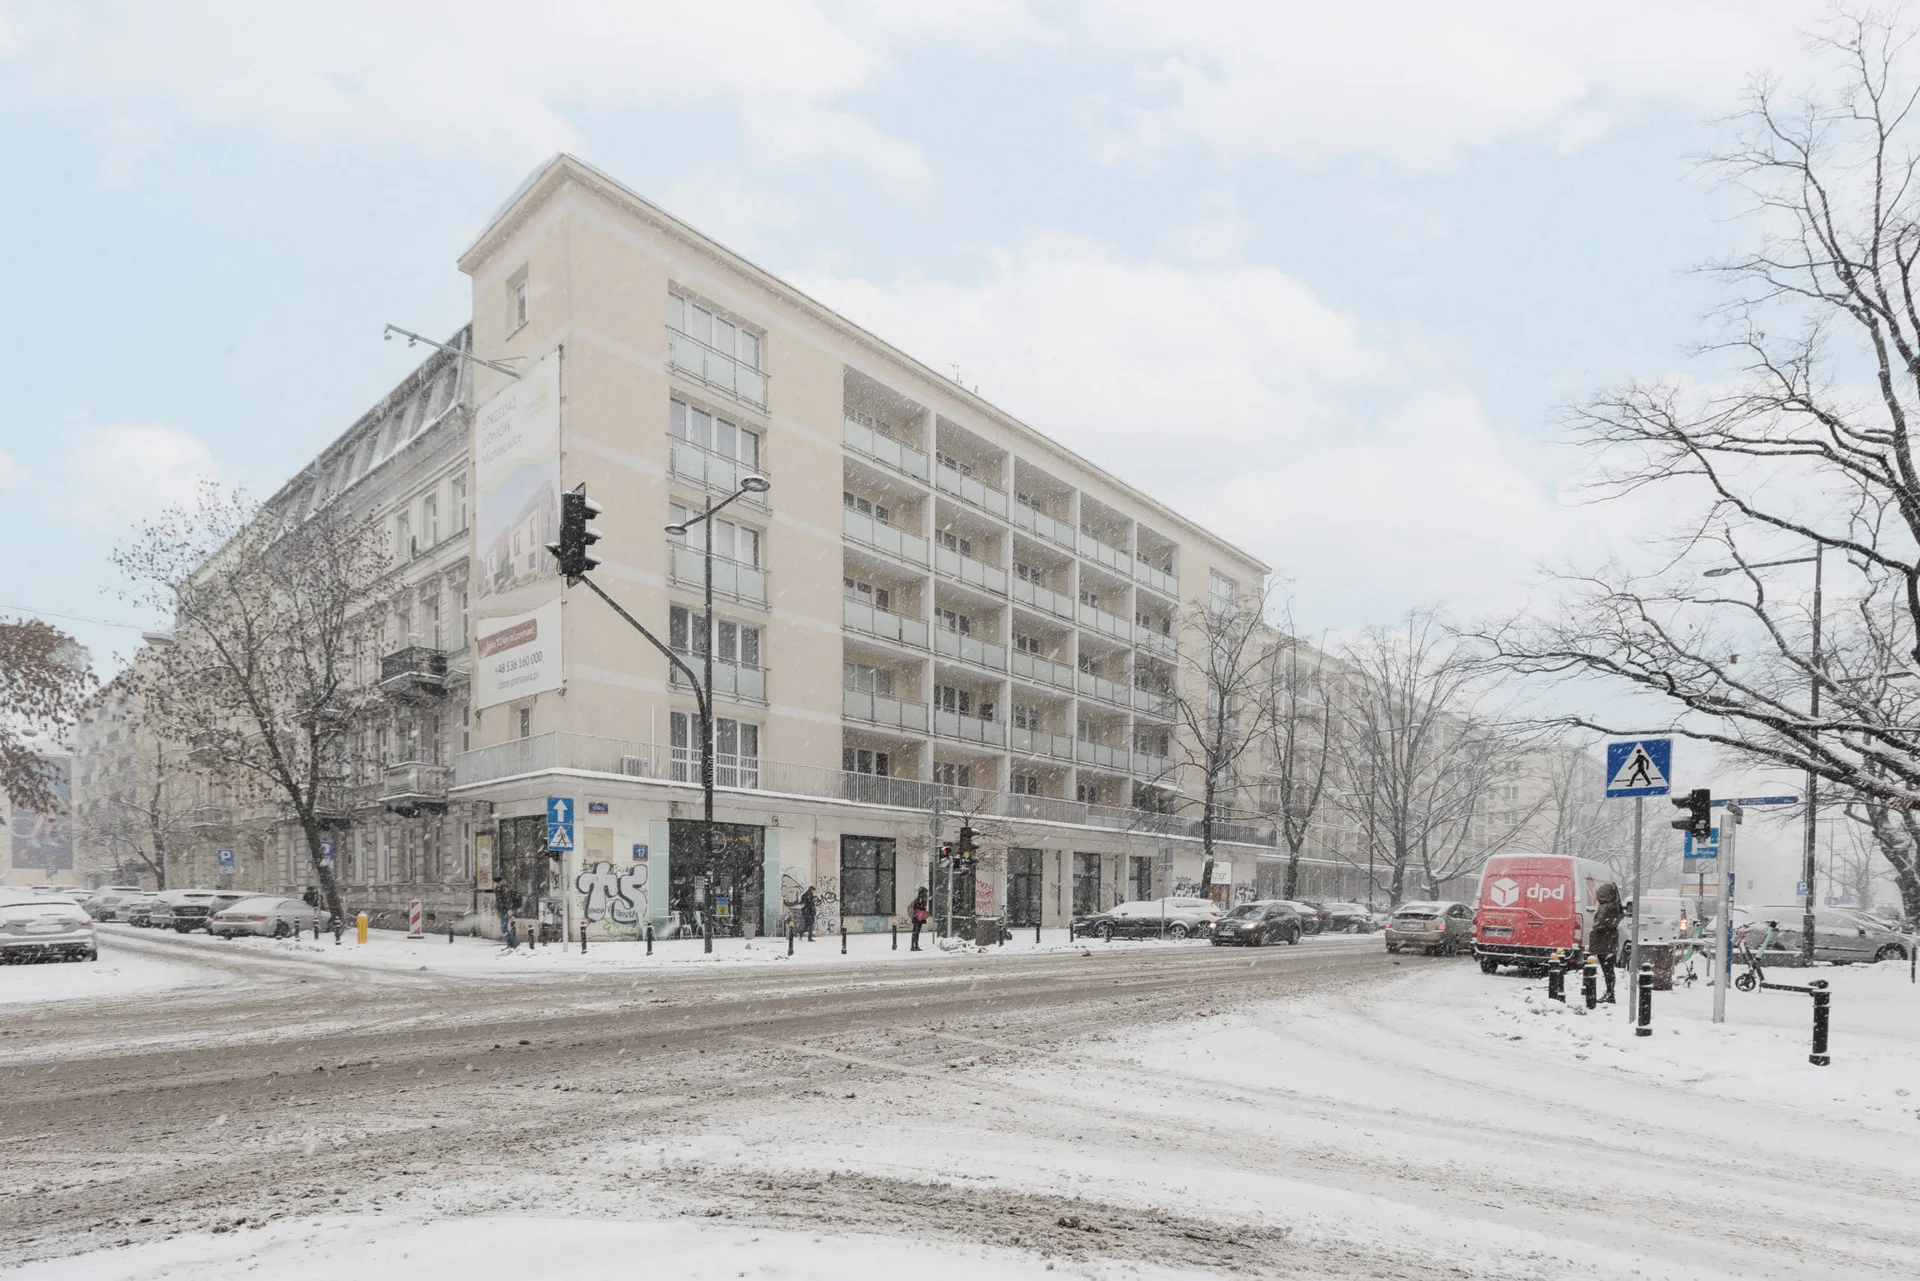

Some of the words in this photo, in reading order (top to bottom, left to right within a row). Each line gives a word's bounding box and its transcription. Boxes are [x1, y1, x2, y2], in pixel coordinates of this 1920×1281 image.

[530, 651, 543, 664] 000
[220, 850, 231, 861] P
[635, 848, 646, 858] 17
[1526, 883, 1565, 902] dpd
